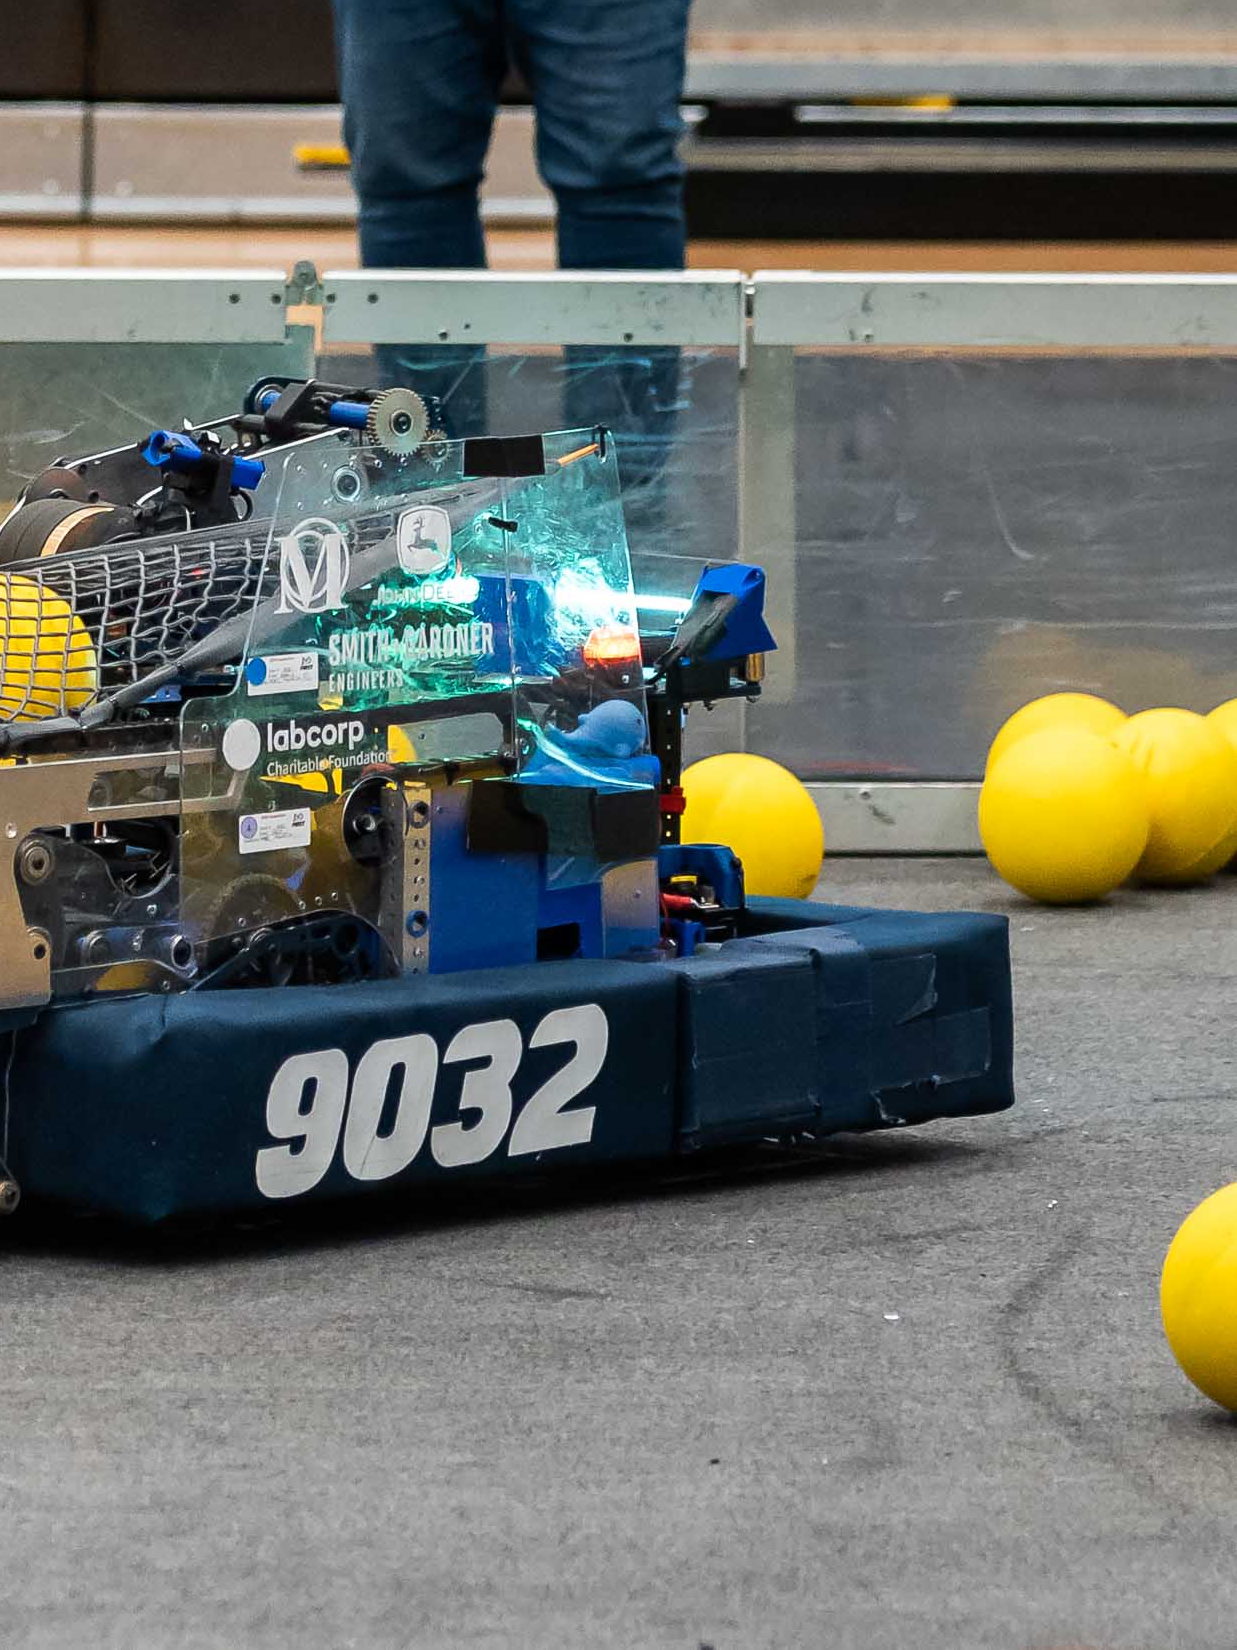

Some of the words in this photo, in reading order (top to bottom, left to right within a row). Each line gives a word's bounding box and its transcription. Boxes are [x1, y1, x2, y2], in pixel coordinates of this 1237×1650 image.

[422, 580, 479, 602] DEE
[328, 668, 404, 693] ENGINEERS
[267, 719, 365, 752] labcorp
[267, 756, 329, 777] Charitable
[328, 750, 395, 769] Foundation
[255, 1002, 609, 1199] 9032
